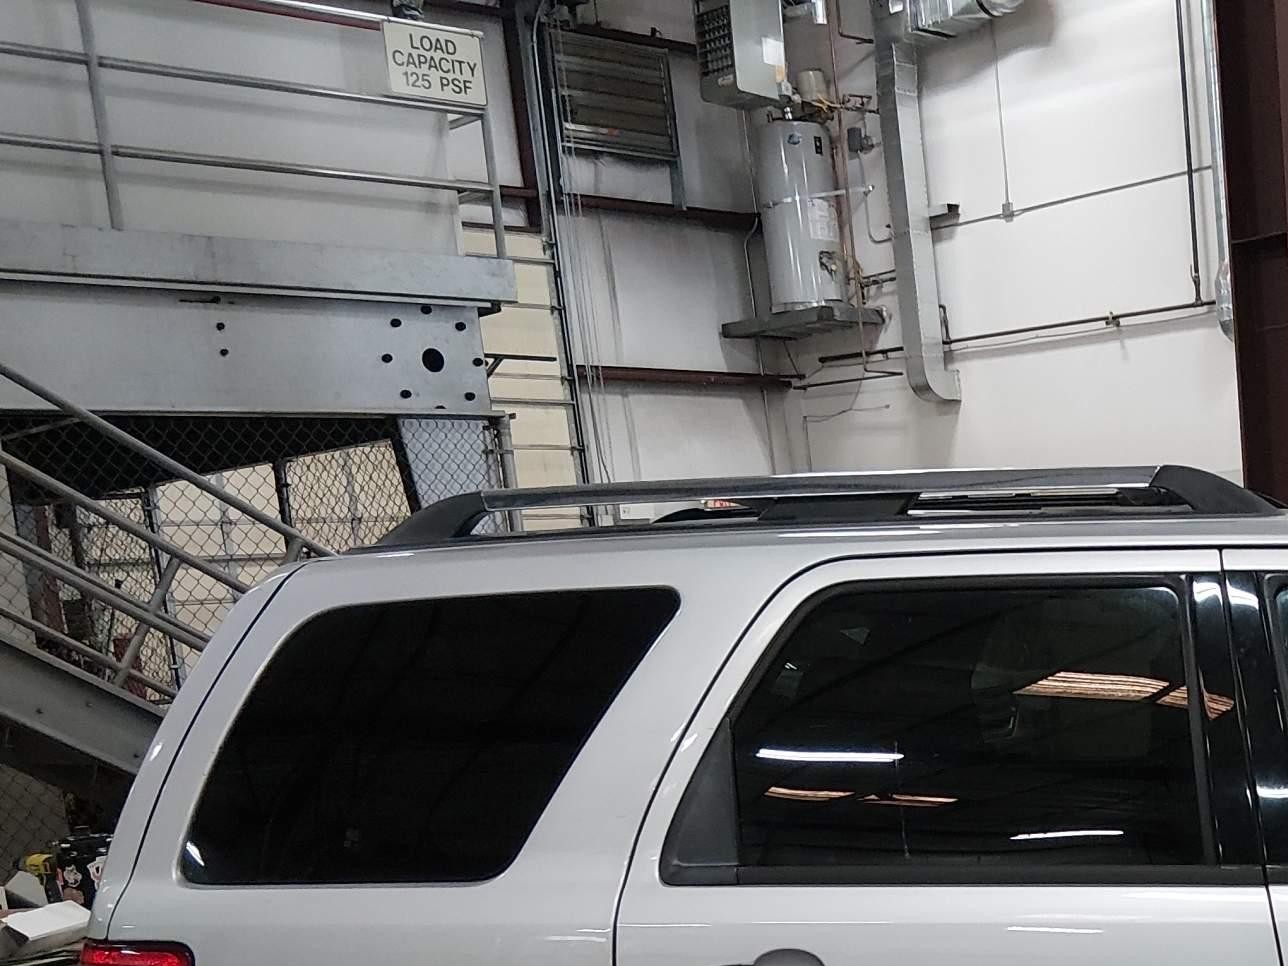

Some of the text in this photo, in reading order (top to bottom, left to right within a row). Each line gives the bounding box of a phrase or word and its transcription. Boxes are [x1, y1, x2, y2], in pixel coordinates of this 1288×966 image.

[409, 33, 457, 56] LOAD
[392, 49, 477, 77] CAPACITY
[402, 71, 473, 95] 125 PSF
